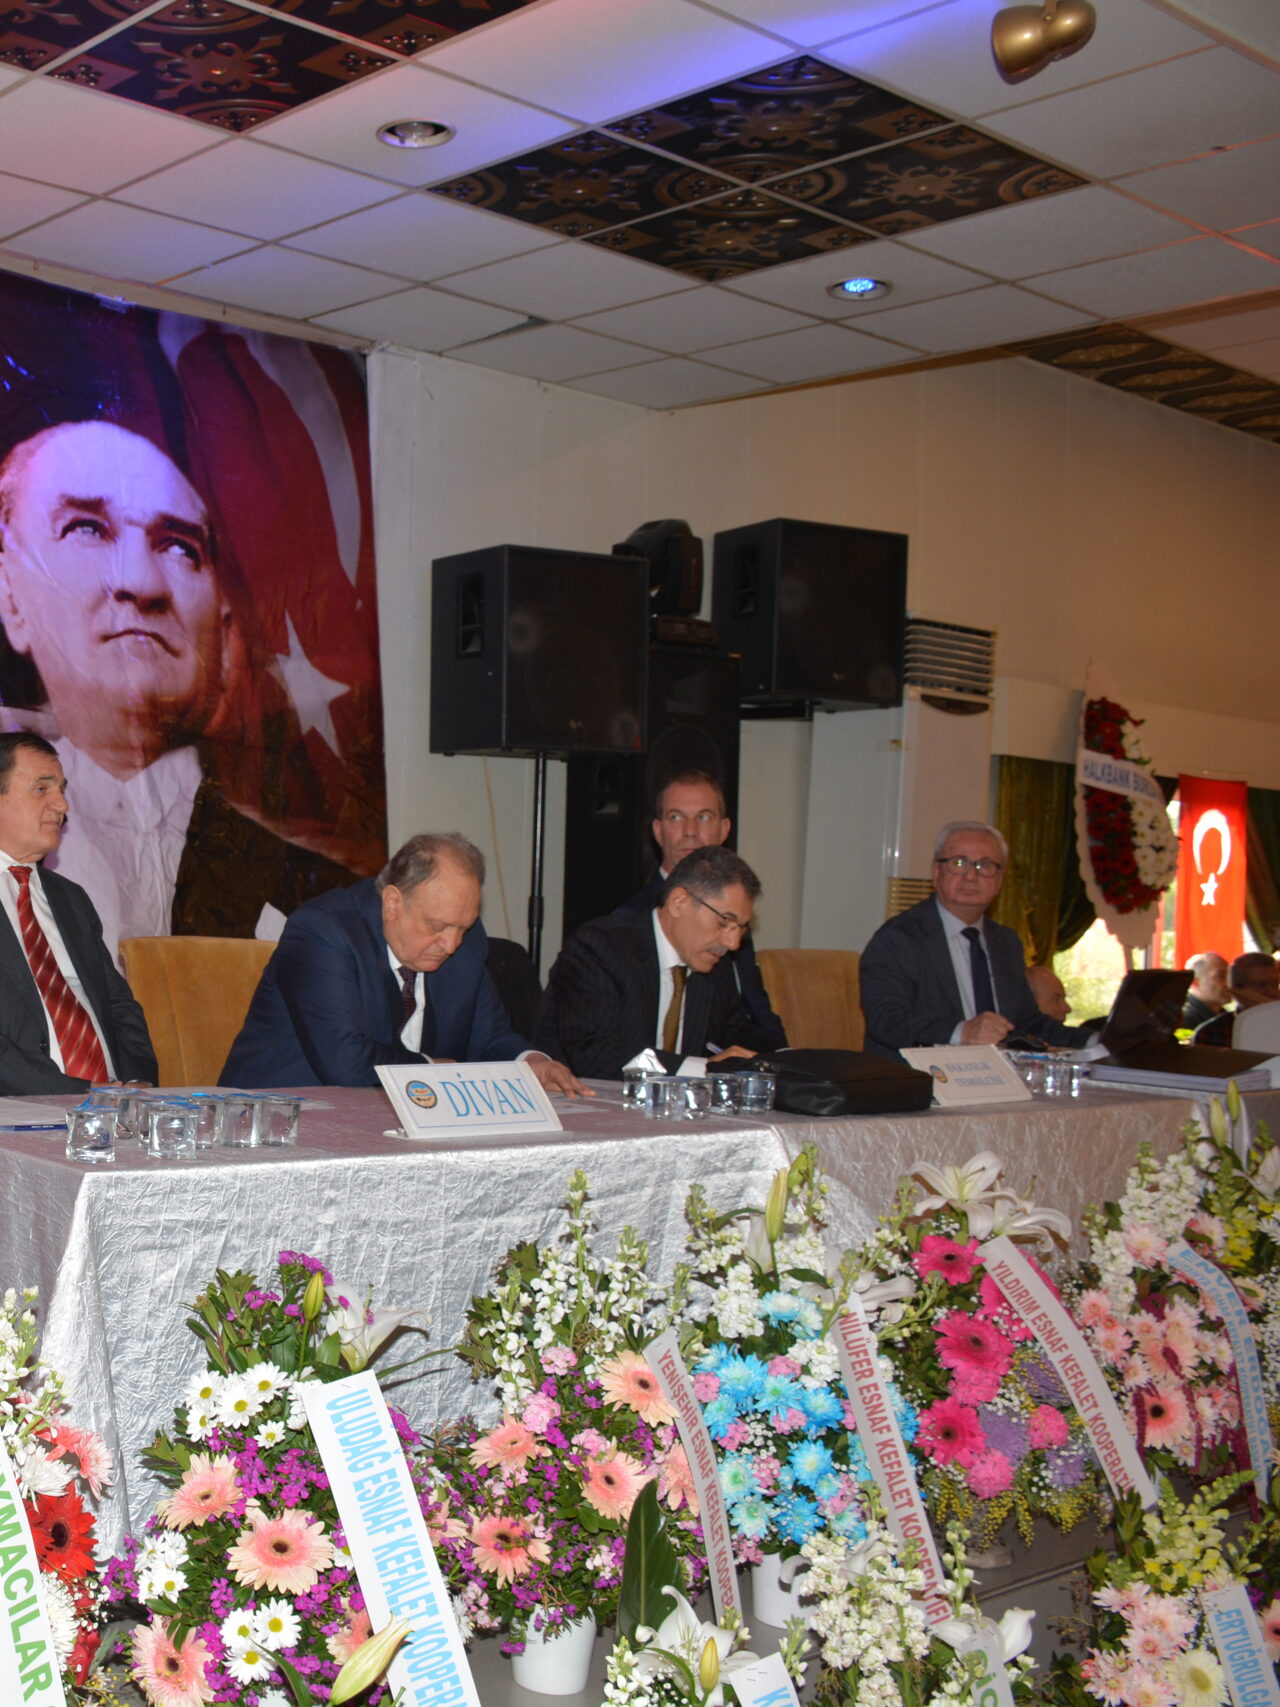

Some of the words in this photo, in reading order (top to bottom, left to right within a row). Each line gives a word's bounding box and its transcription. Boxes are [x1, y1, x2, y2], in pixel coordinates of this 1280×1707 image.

[438, 1072, 538, 1117] DİVAN
[991, 1260, 1040, 1316] YILDIRIM
[1031, 1312, 1069, 1353] ESNAF
[1058, 1353, 1099, 1413] KEFALET
[326, 1388, 402, 1473] ULUDAĞ
[657, 1348, 699, 1433] YENİŞEHİR
[691, 1429, 714, 1481] ESNAF
[705, 1480, 725, 1548] KEFALET
[838, 1311, 875, 1382] NİLÜFER
[858, 1382, 892, 1435] ESNAF
[875, 1438, 914, 1510] KEFALET
[352, 1467, 413, 1536] ESNAF
[372, 1533, 440, 1621] KEFALET
[403, 1621, 469, 1707] KOOPER
